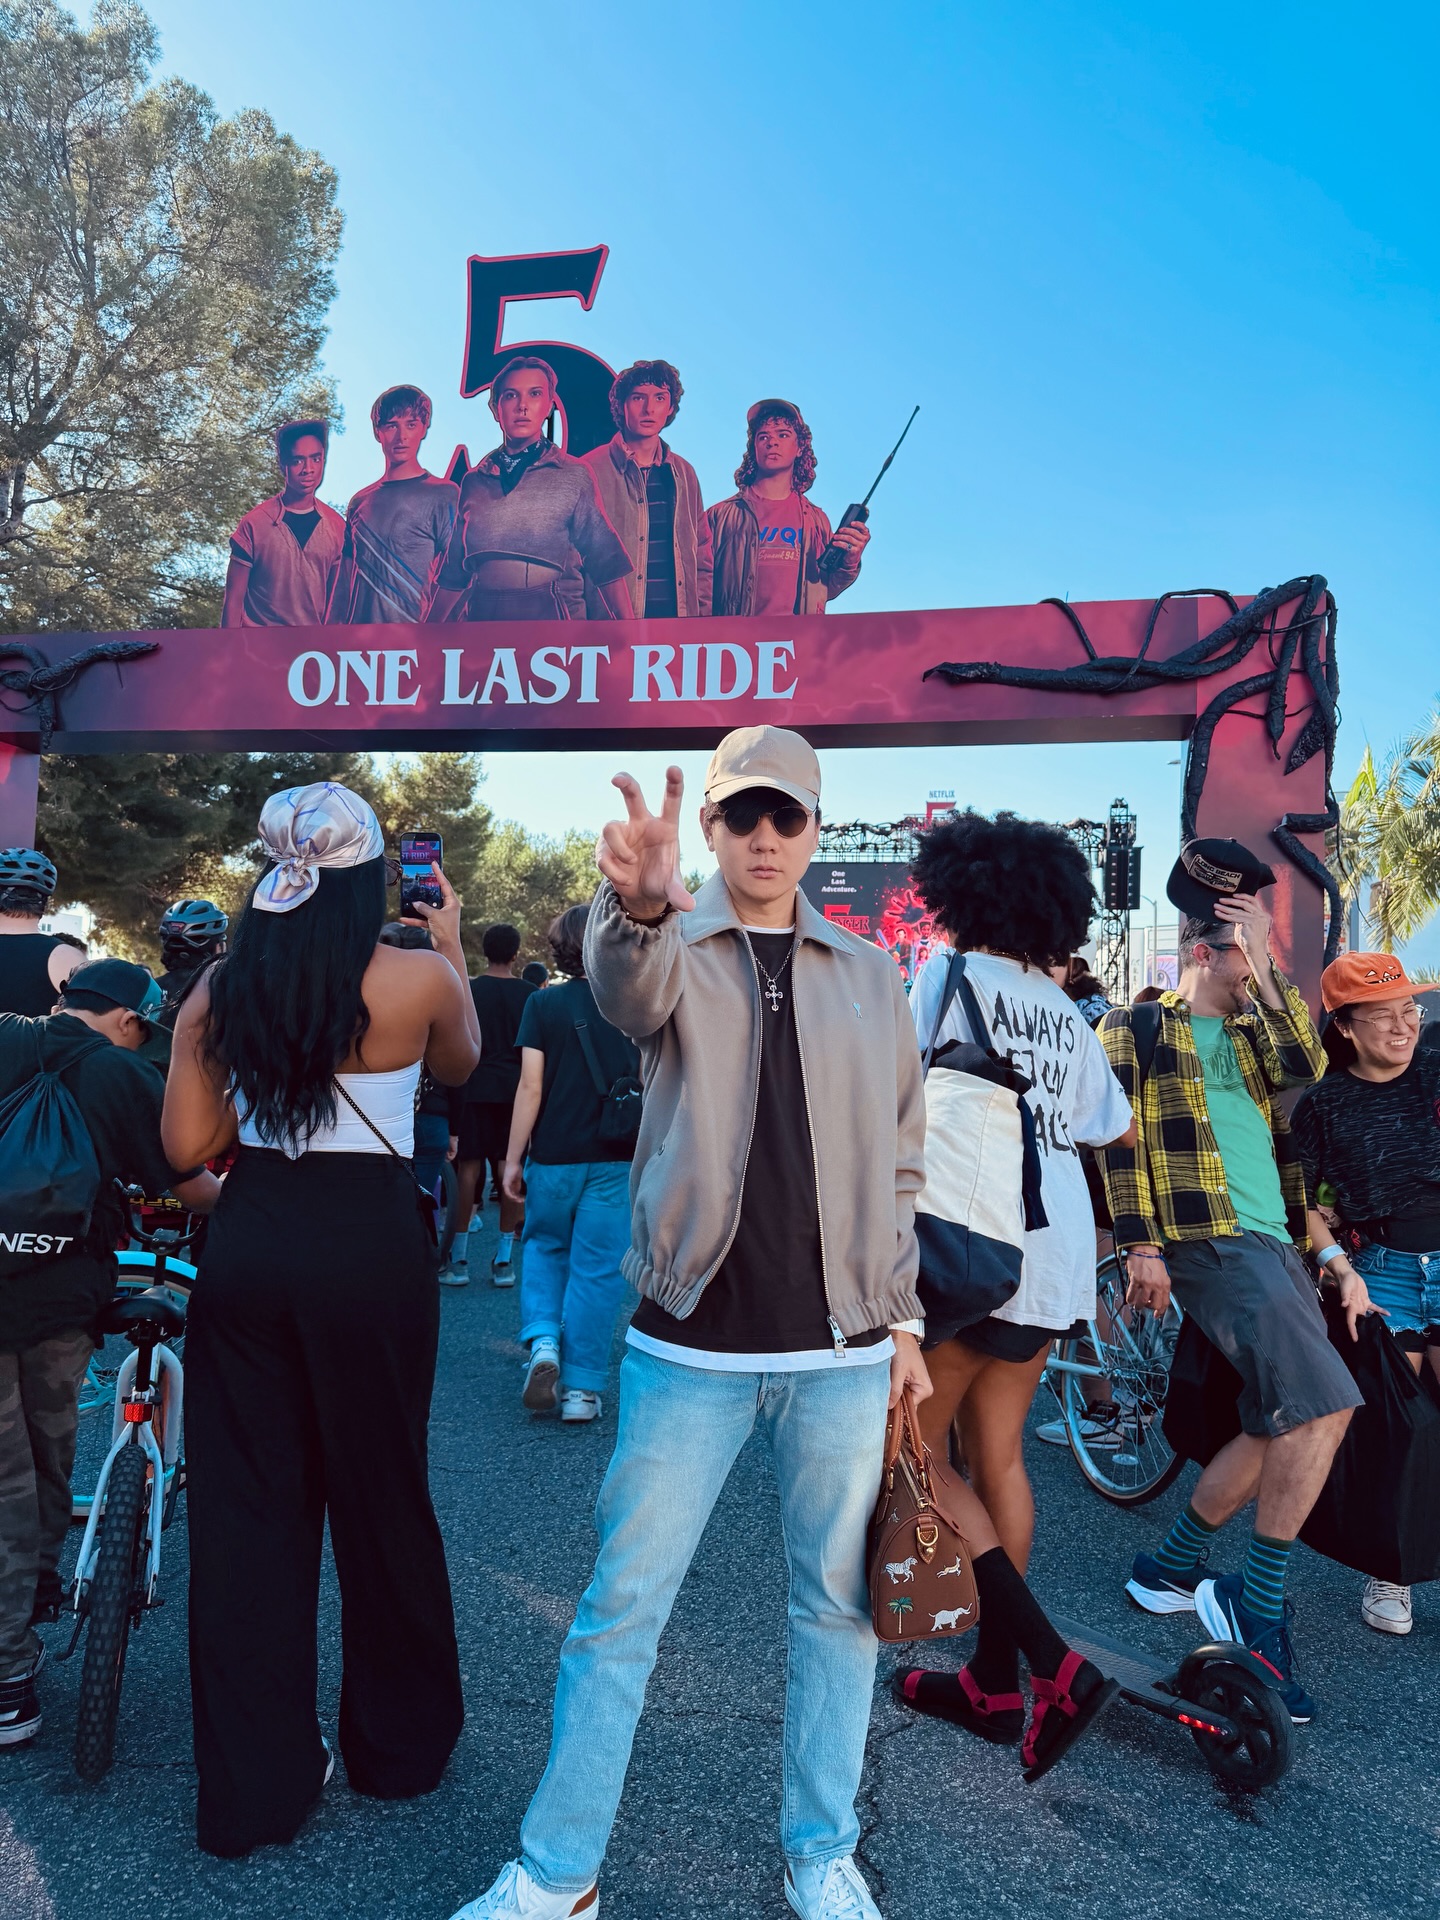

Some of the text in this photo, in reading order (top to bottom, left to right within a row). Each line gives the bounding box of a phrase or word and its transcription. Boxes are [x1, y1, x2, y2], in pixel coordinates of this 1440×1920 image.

[288, 640, 798, 706] ONE LAST RIDE
[929, 790, 955, 798] NETFLIX
[1196, 859, 1240, 879] LONG BEACH
[992, 990, 1075, 1054] ALWAYS
[0, 1233, 74, 1254] NEST
